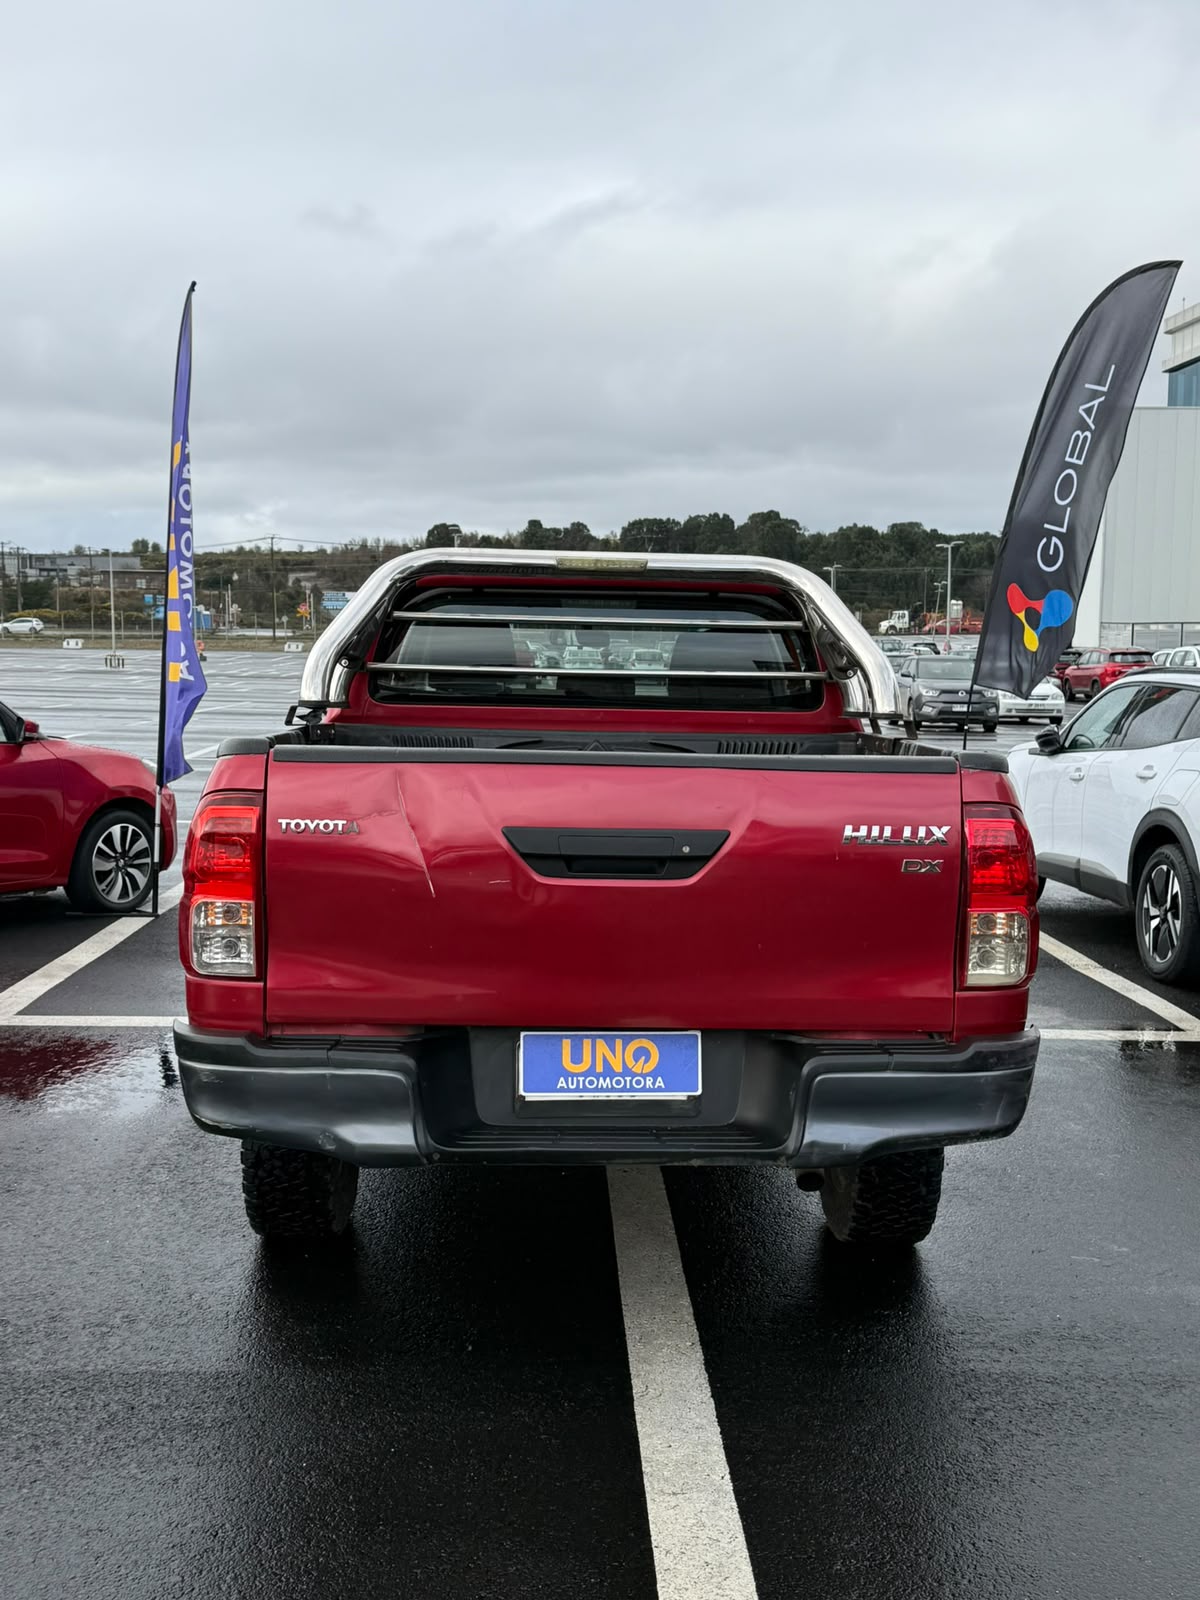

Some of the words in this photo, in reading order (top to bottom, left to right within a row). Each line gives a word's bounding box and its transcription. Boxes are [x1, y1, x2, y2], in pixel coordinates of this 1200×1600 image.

[1037, 364, 1116, 573] GLOBAL
[277, 818, 360, 834] TOYOTA
[842, 824, 952, 846] HILUX
[901, 858, 945, 874] DX
[561, 1037, 660, 1075] UNO
[556, 1075, 666, 1090] AUTOMOTORA
